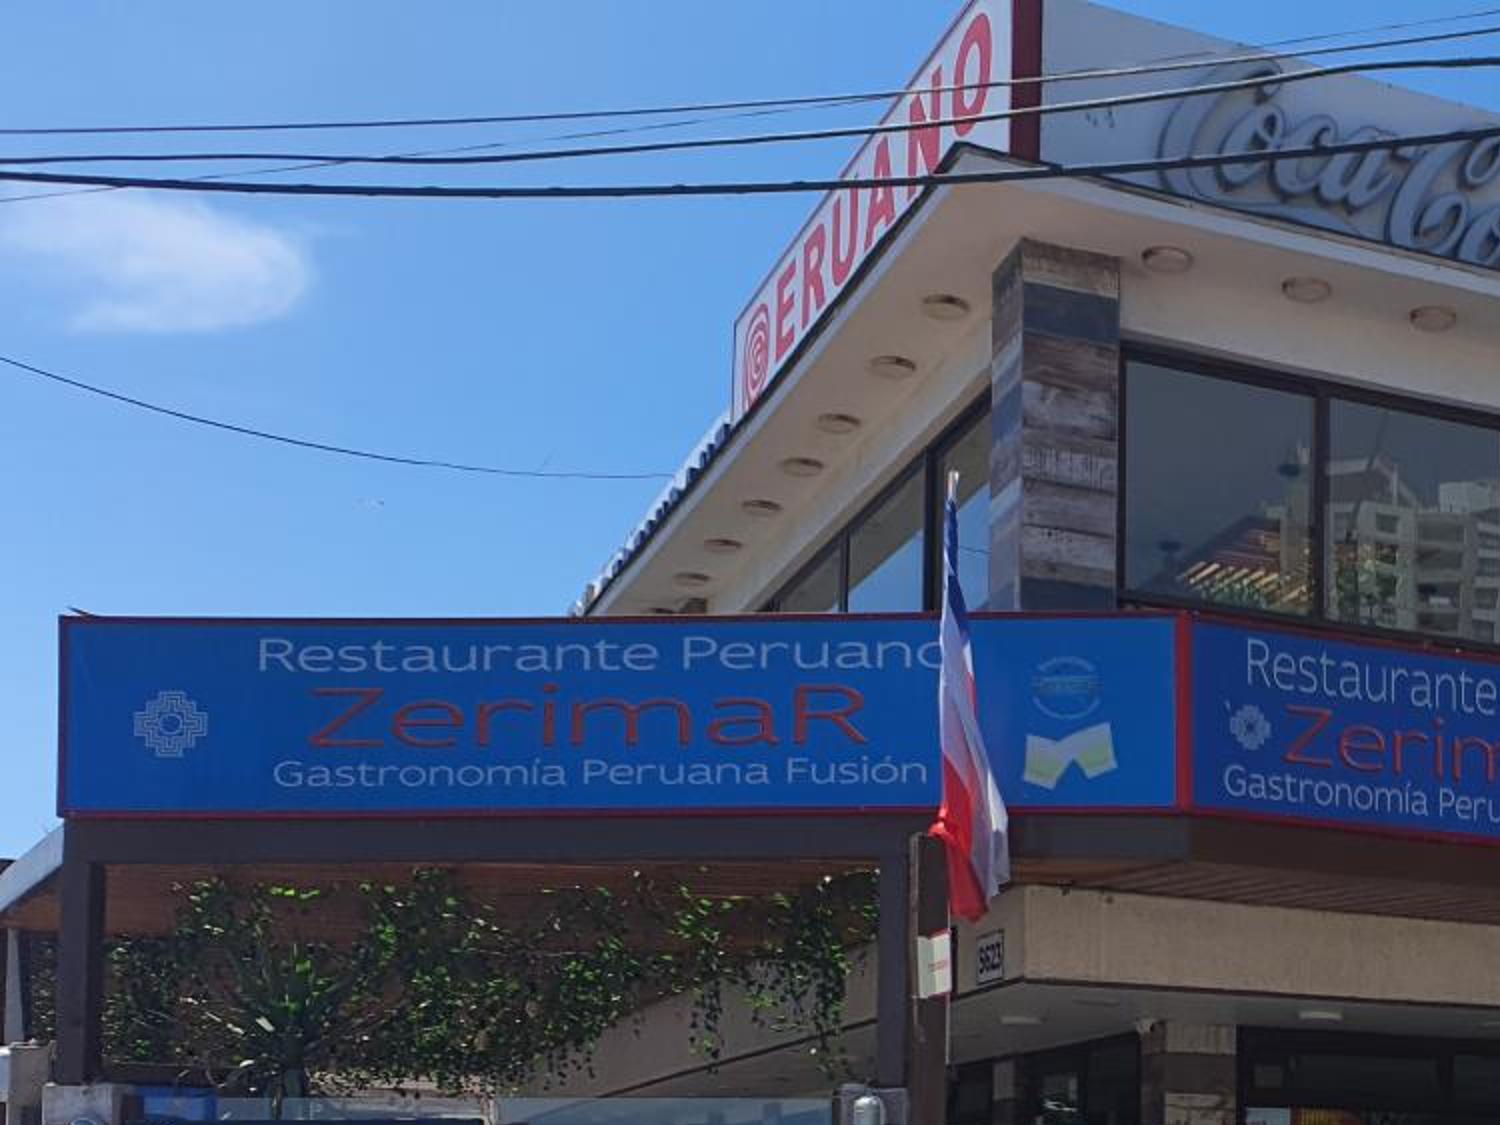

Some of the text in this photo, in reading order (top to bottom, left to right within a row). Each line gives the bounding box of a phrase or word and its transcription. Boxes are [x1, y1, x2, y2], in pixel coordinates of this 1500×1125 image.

[257, 634, 943, 672] Restaurante Peruano
[1246, 637, 1499, 717] Restaurante
[307, 682, 870, 748] ZerimaR
[271, 754, 928, 788] Gastronomía Peruana Fusión
[1223, 764, 1429, 817] Gastronomía
